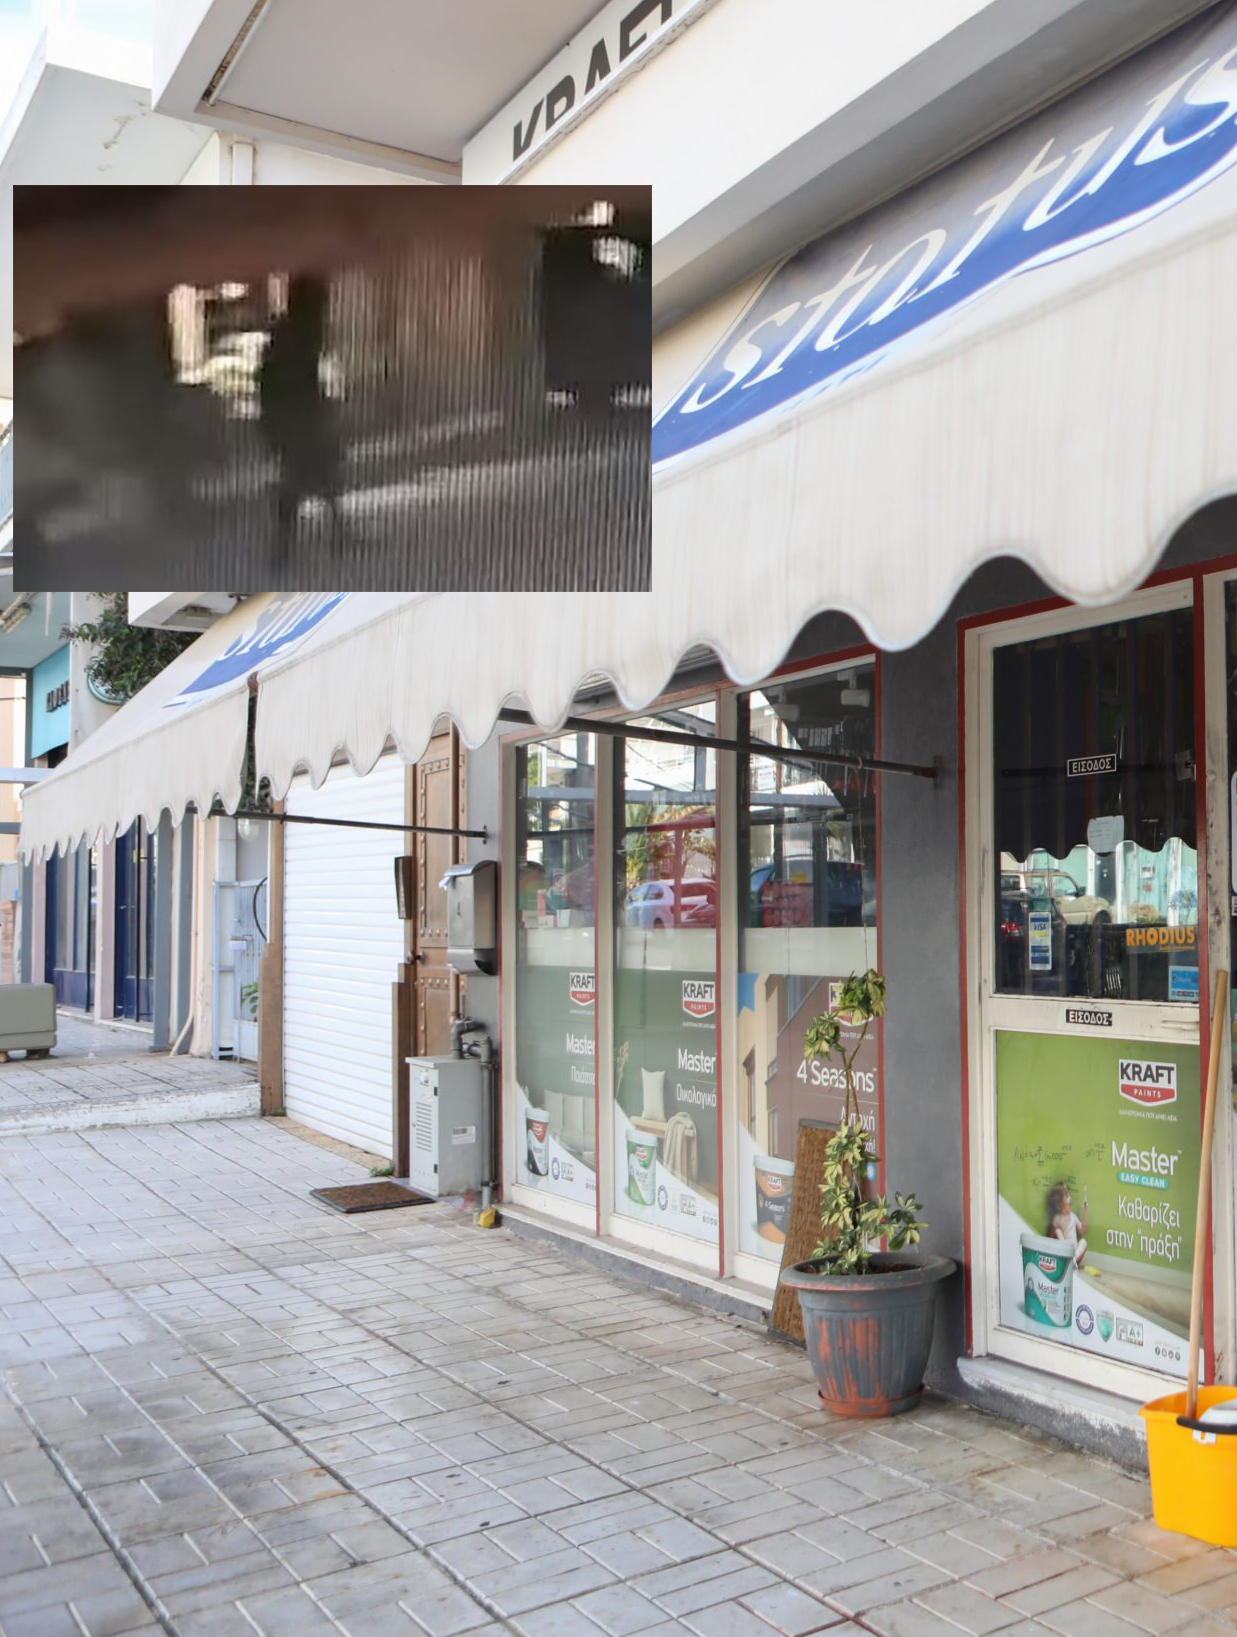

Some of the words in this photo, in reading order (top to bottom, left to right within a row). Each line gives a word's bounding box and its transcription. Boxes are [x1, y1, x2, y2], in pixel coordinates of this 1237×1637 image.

[1072, 757, 1112, 773] ΕΙΣΟΔΟΣ
[1126, 926, 1196, 947] RHODIUS
[683, 983, 715, 999] KRAFT
[1069, 1011, 1110, 1025] ΕΙΣΟΔΟΣ
[678, 1048, 716, 1074] Master
[797, 1060, 807, 1084] 4
[1120, 1062, 1174, 1085] KRAFT
[676, 1083, 717, 1109] Οικολογικό
[1133, 1089, 1162, 1098] PAINTS
[1111, 1141, 1179, 1176] Master
[1120, 1173, 1139, 1184] EASY
[1141, 1176, 1165, 1189] CLEAN
[1118, 1195, 1180, 1230] Καθαρίζει
[1106, 1229, 1134, 1250] στην
[1039, 1256, 1056, 1265] KRAFT
[1037, 1281, 1060, 1296] Master
